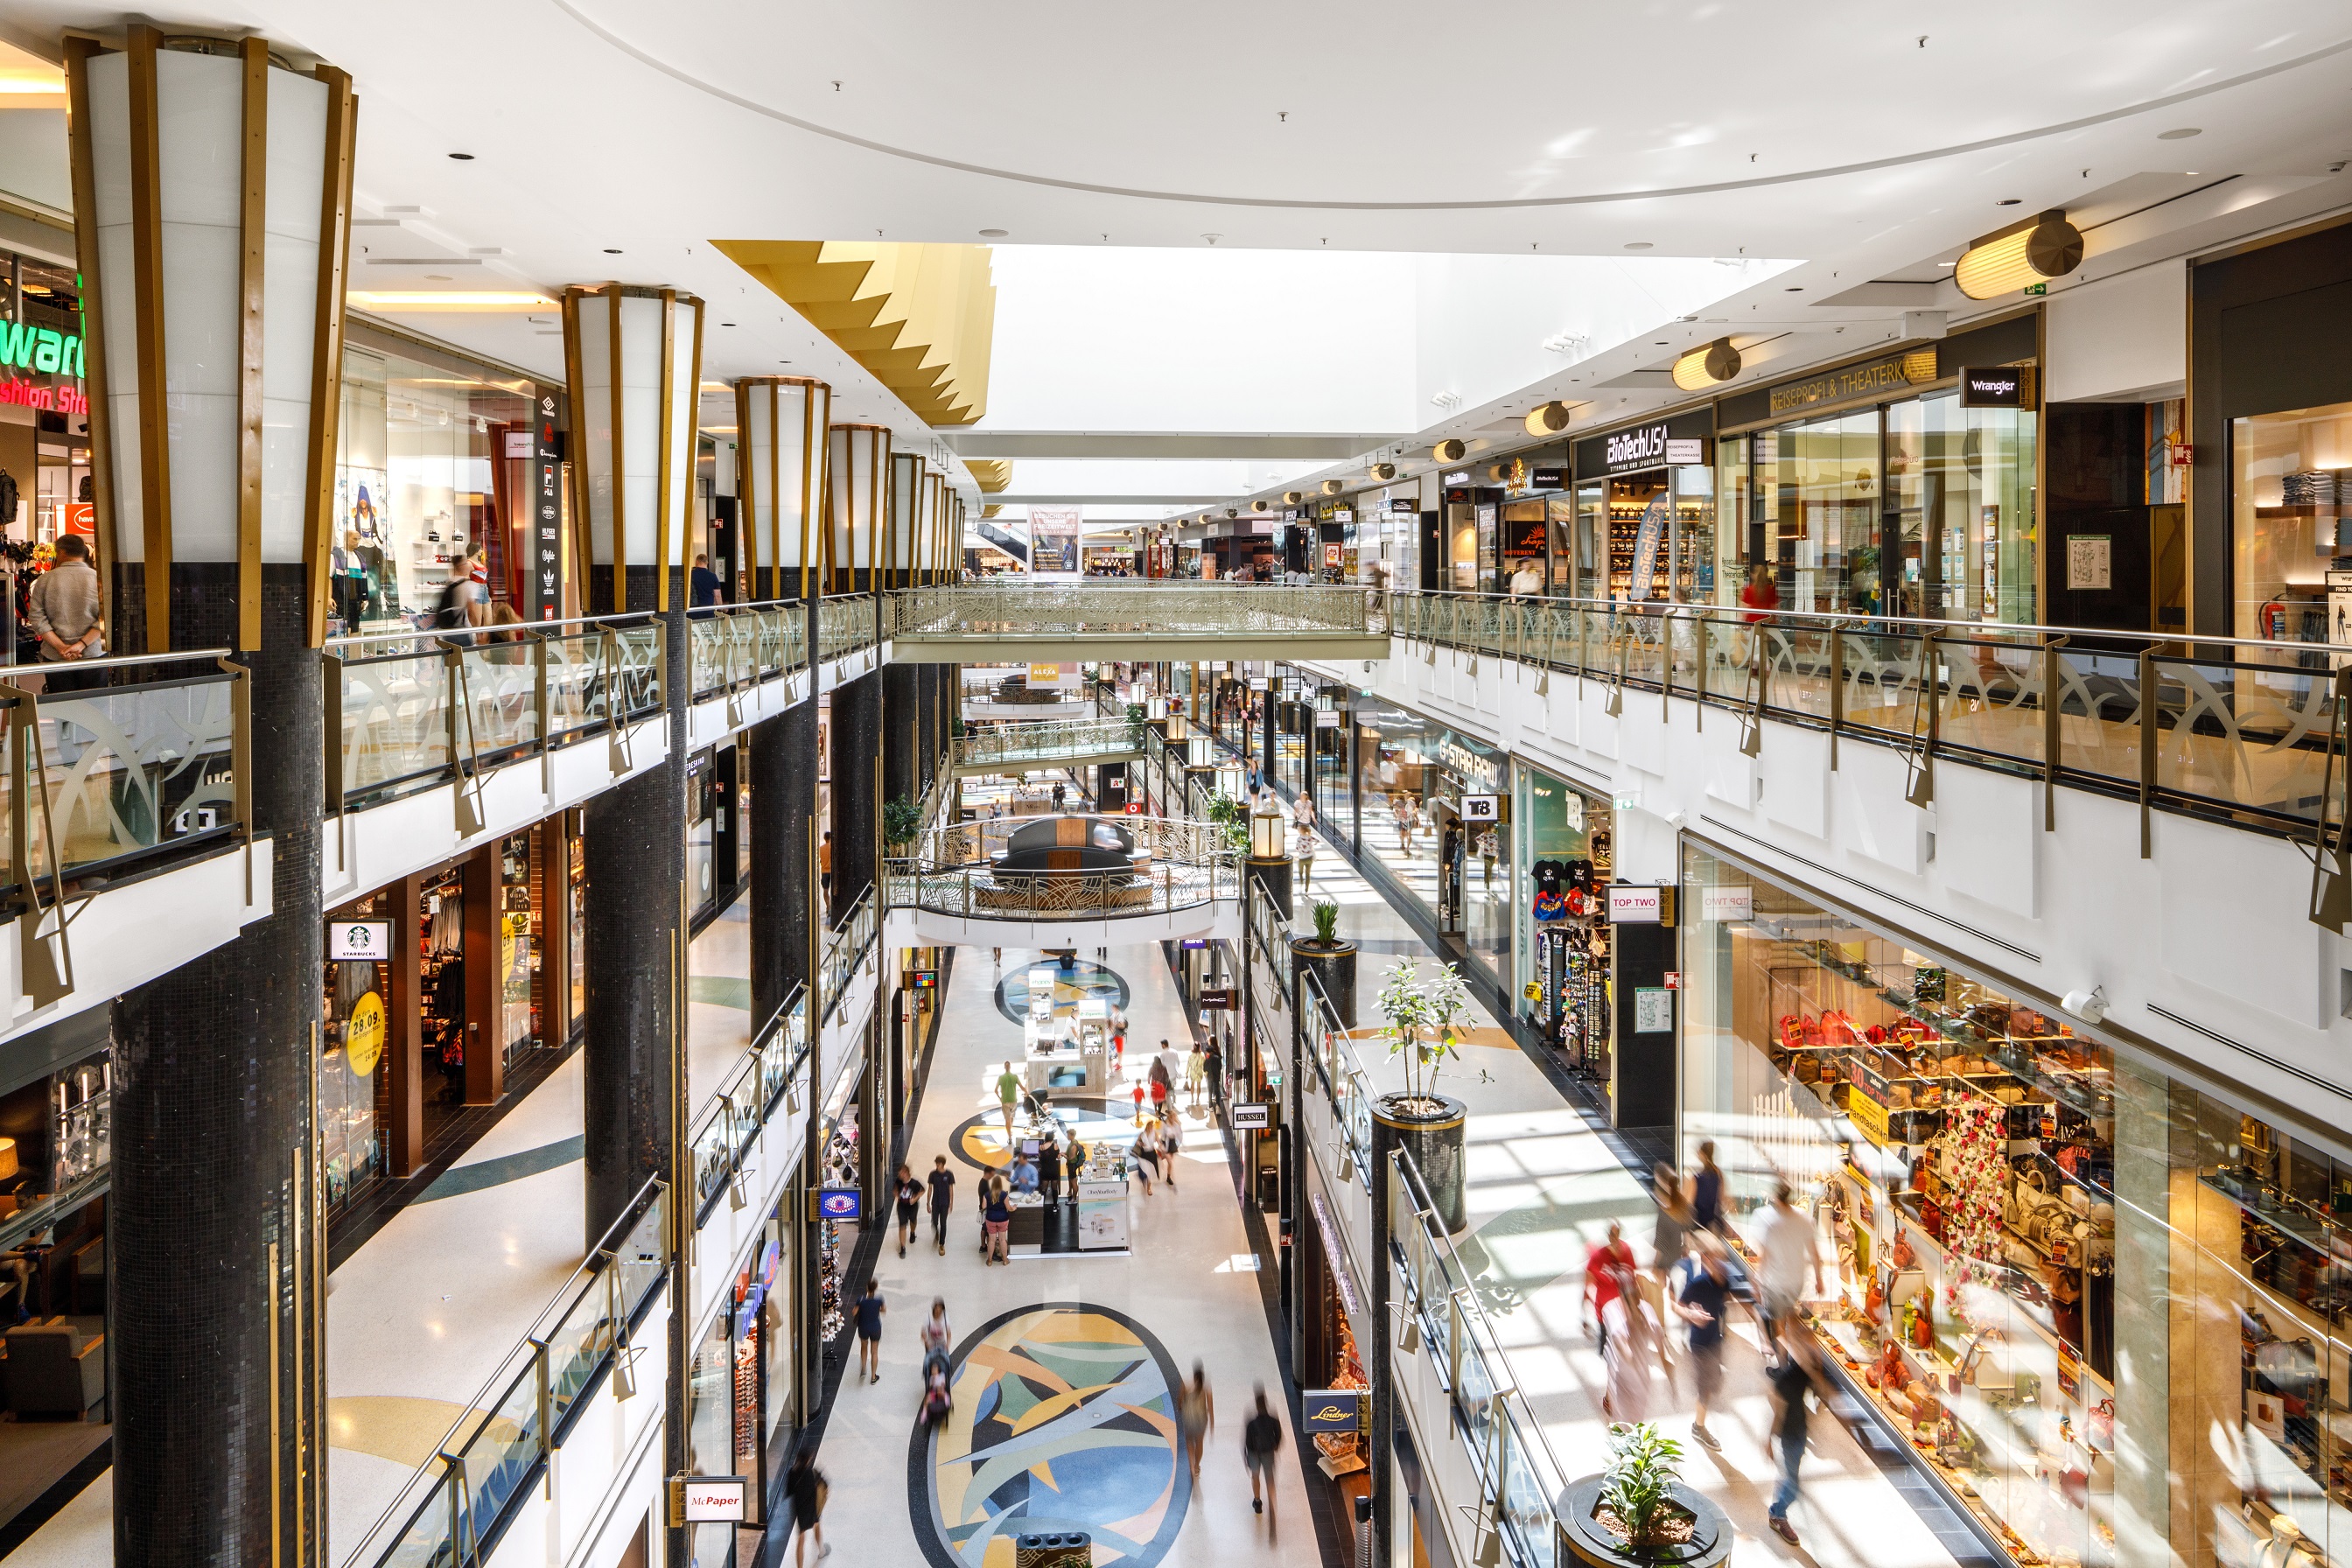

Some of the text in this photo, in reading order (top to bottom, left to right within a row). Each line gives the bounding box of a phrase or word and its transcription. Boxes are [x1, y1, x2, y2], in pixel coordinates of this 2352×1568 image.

[1772, 353, 1936, 411] REISEPROFI & THEATERKASSE
[1970, 380, 2015, 395] Wrangler
[1606, 424, 1668, 464] BioTechUSA
[543, 487, 554, 496] FILA
[1636, 505, 1666, 590] BioTechUSA
[1033, 667, 1056, 677] ALEXA
[1474, 754, 1497, 788] RAW
[353, 1011, 381, 1036] 28.09.
[1850, 1062, 1865, 1088] 30
[1869, 1075, 1882, 1090] Jahre
[1864, 1082, 1888, 1107] TOP TWO
[1849, 1104, 1888, 1142] Handtaschen
[1310, 1405, 1354, 1422] Lindner
[691, 1496, 739, 1508] McPaper
